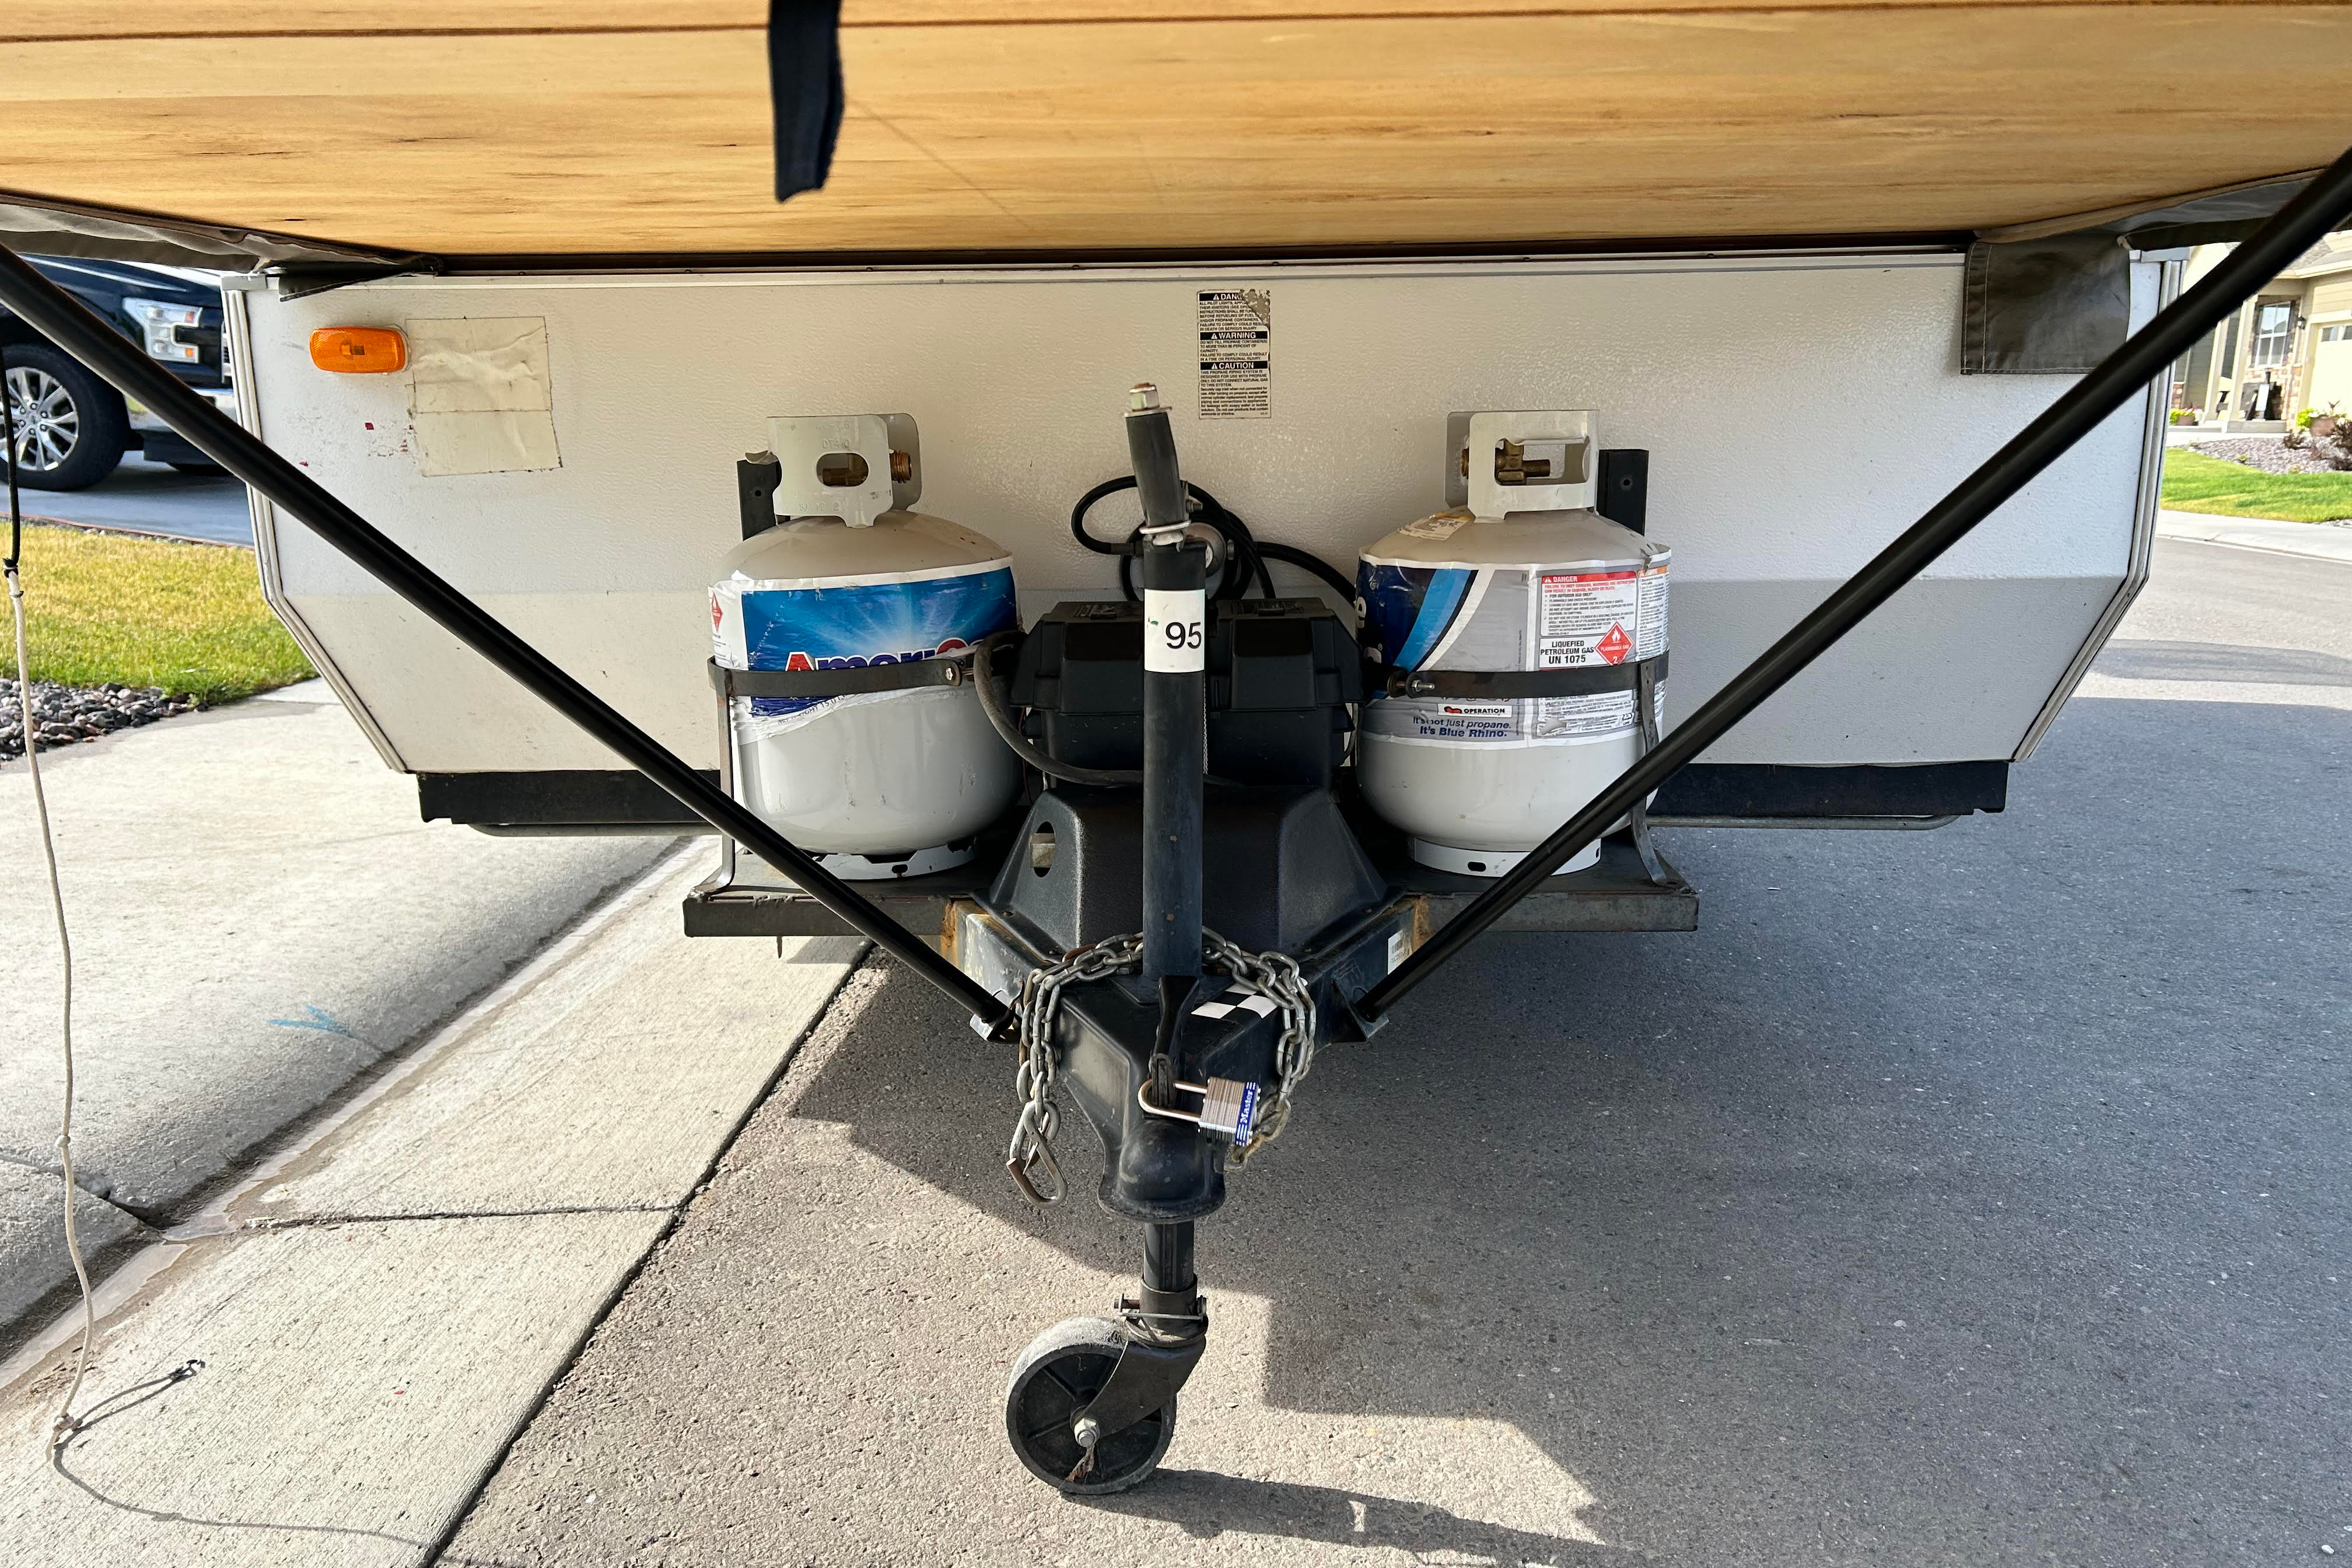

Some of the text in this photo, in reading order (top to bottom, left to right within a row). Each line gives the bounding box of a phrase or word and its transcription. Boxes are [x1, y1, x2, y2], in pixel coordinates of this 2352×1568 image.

[1166, 622, 1202, 649] 95
[1549, 654, 1586, 664] UN 1075
[1613, 656, 1618, 664] 2
[1445, 719, 1464, 727] just
[1466, 721, 1511, 729] propane.
[1420, 726, 1507, 738] It's Blue Rhino.
[1240, 1090, 1254, 1124] Master
